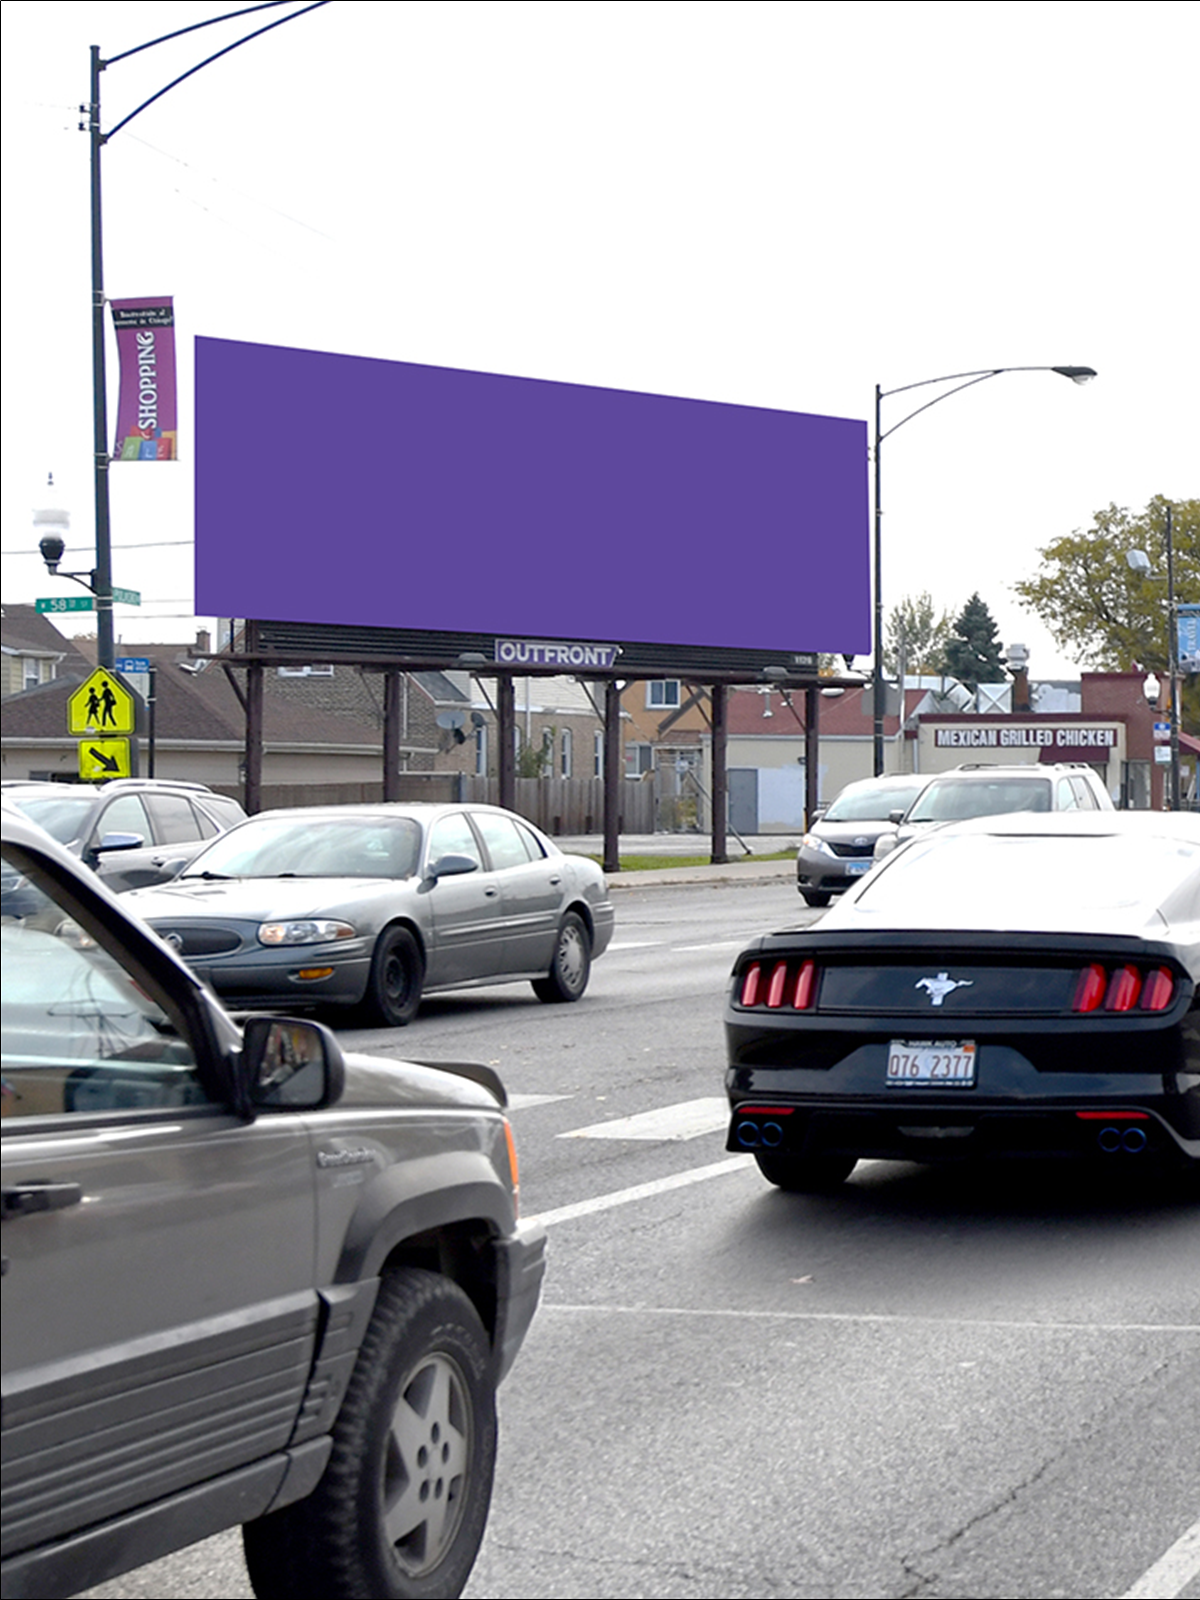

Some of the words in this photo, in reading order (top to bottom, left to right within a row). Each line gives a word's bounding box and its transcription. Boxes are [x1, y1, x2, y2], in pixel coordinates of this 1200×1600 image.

[136, 331, 158, 430] SHOPPING
[500, 643, 612, 667] OUTFRONT
[938, 729, 997, 746] MEXICAN
[1001, 730, 1053, 747] GRILLED
[1056, 730, 1114, 747] CHICKEN
[930, 1055, 973, 1077] 2377
